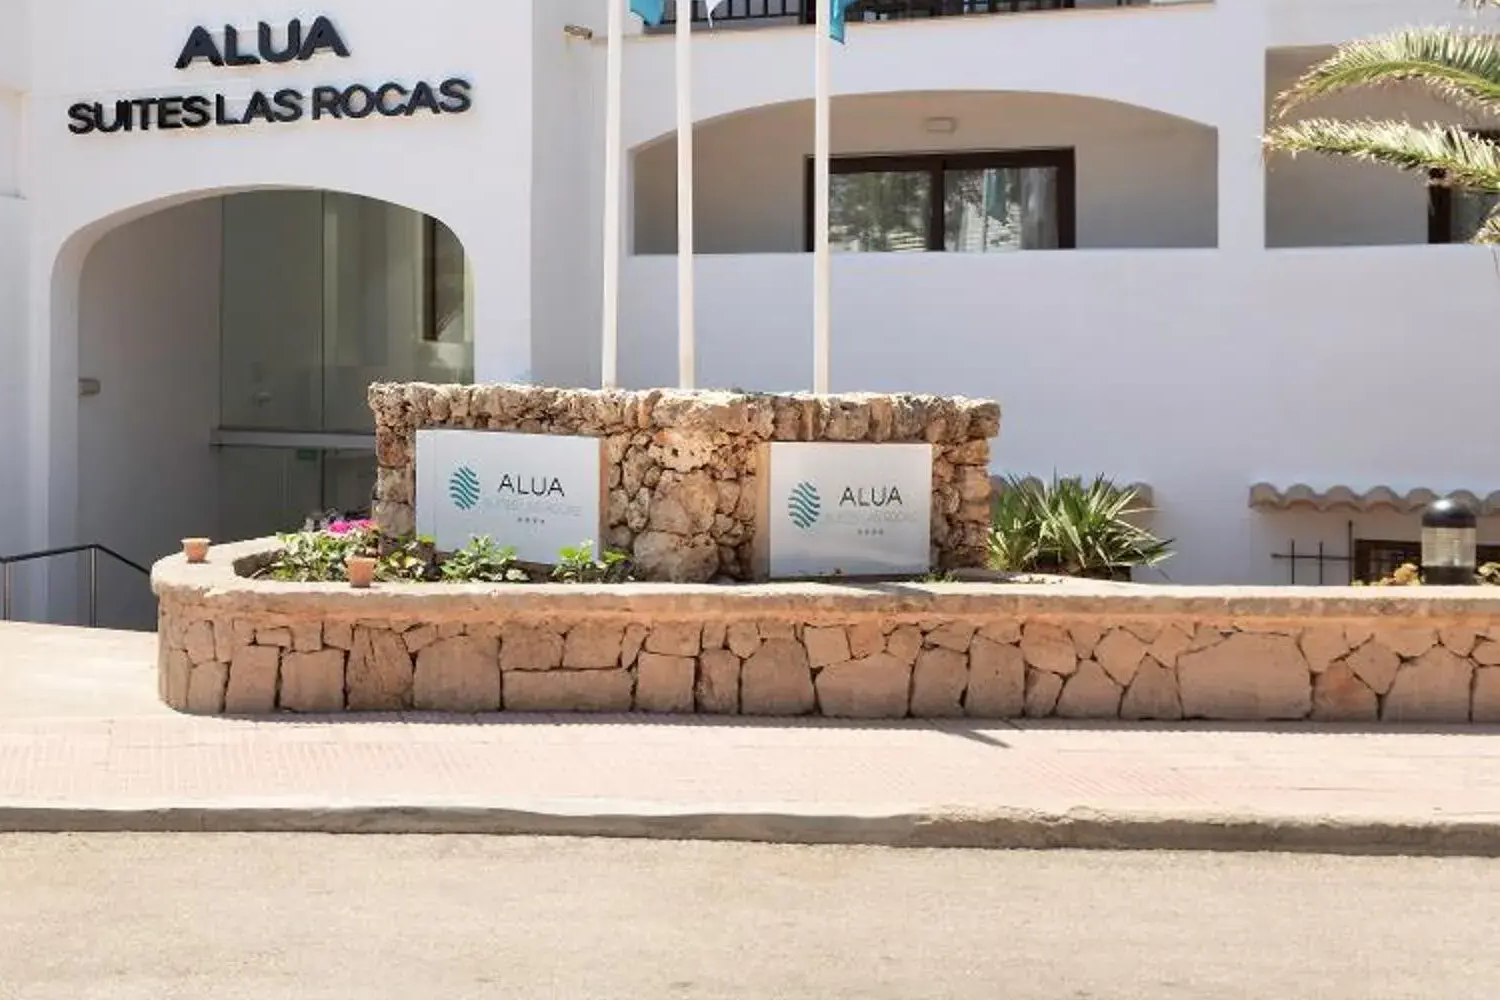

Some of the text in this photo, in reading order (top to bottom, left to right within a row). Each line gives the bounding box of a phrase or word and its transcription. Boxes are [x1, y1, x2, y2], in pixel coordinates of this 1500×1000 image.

[175, 16, 350, 69] ALUA
[68, 78, 471, 134] SUITES LAS ROCAS
[498, 473, 565, 497] ALUA
[838, 485, 903, 507] ALUA
